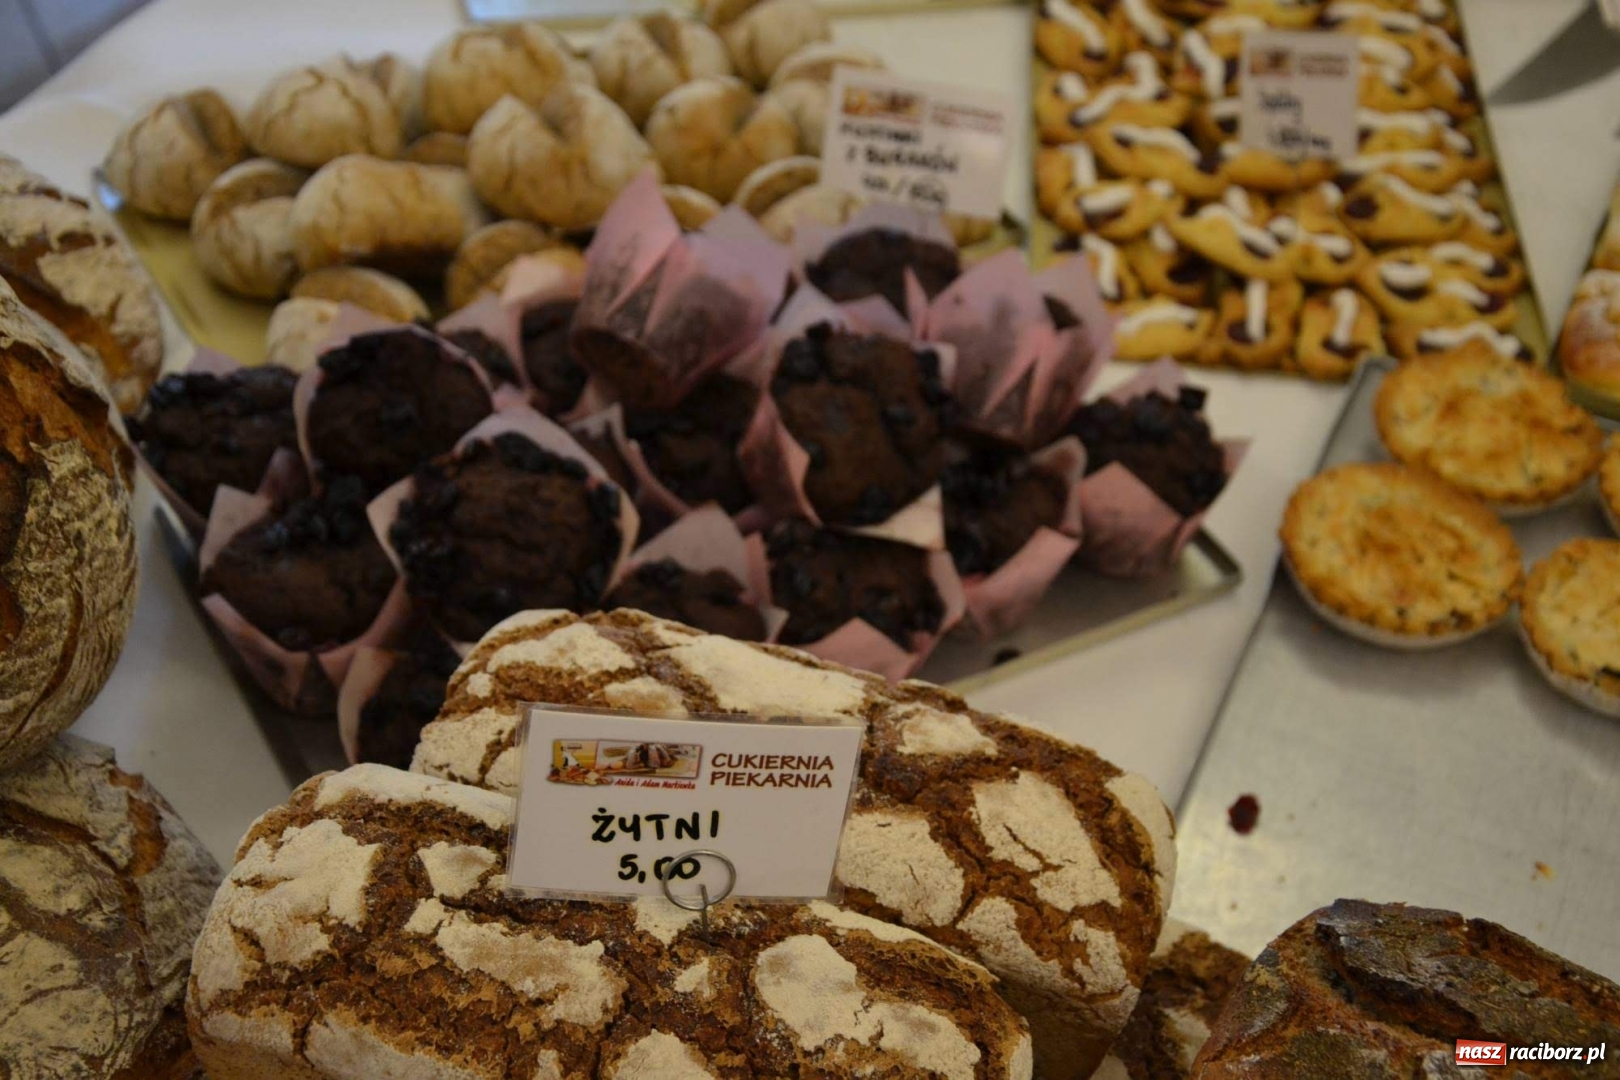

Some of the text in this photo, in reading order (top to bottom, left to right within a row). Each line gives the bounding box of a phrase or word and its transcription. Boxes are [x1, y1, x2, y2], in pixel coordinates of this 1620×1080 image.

[711, 753, 834, 771] CUKIERNIA
[640, 779, 660, 788] Adam
[710, 771, 832, 788] PIEKARNIA
[591, 807, 720, 843] ŻYTNI
[618, 853, 701, 883] 5,00
